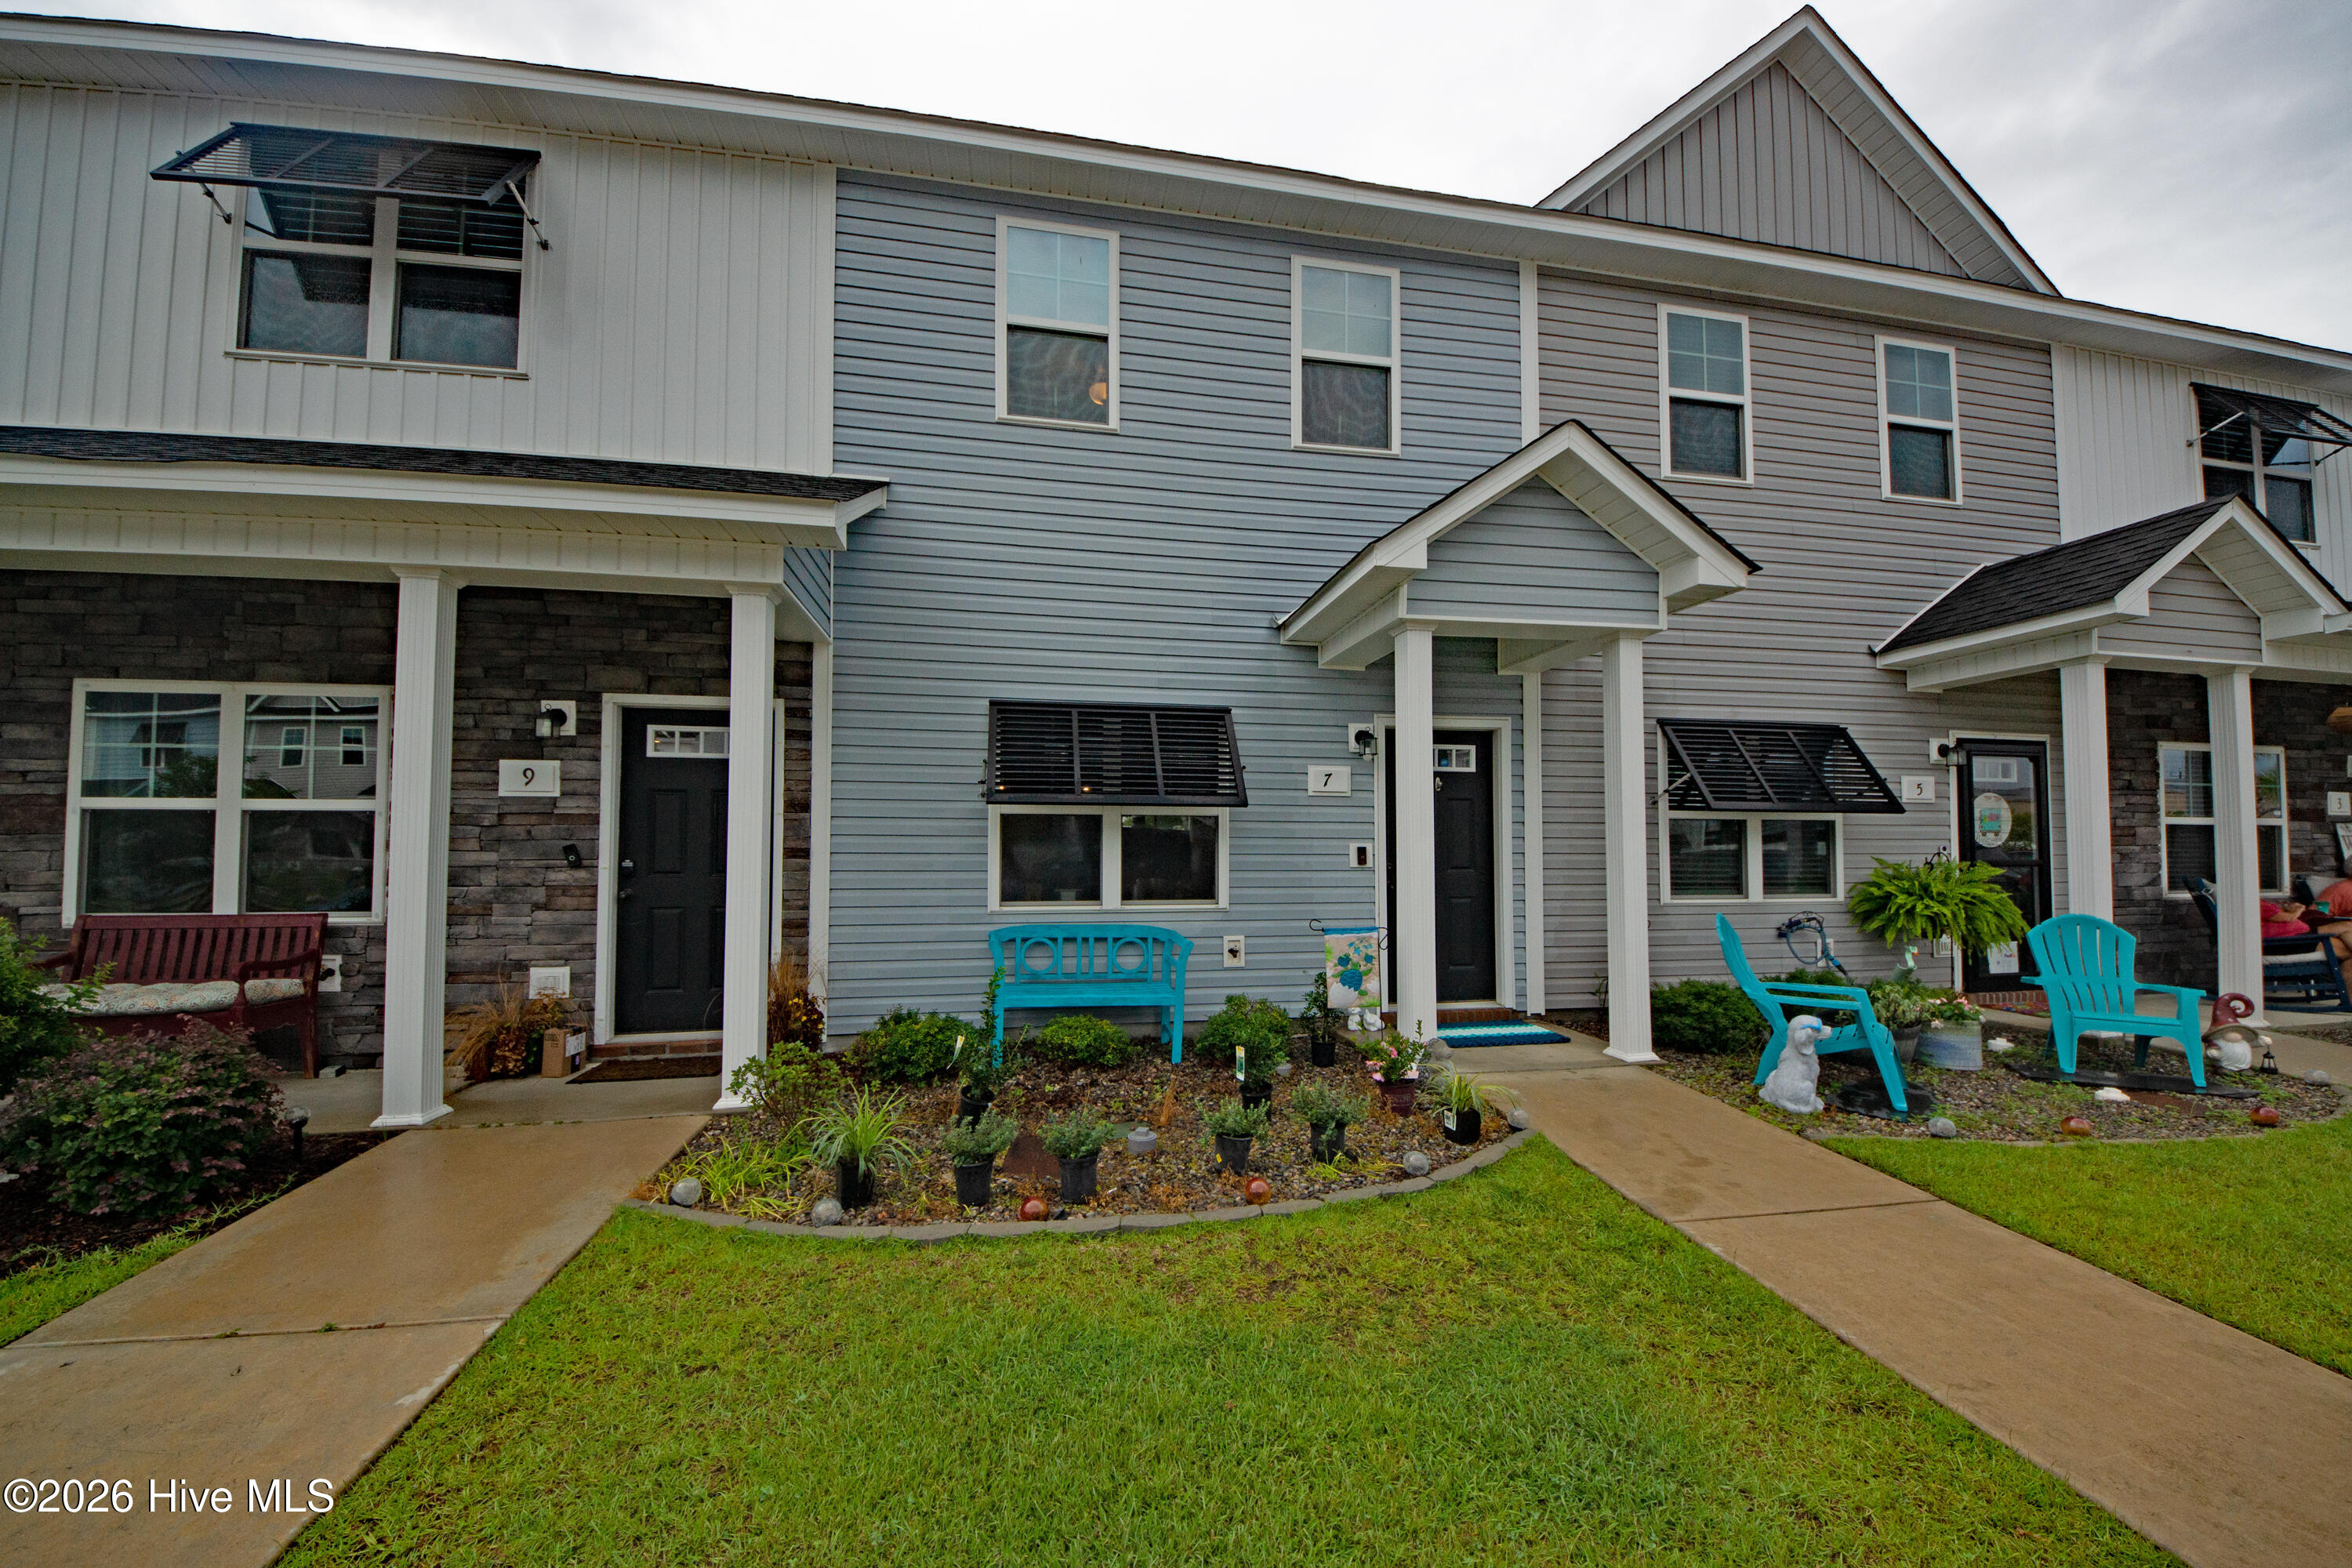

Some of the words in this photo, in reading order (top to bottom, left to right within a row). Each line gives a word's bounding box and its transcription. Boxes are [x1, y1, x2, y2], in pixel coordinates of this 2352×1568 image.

[522, 768, 535, 786] 9
[1323, 772, 1333, 787] 7
[1916, 782, 1923, 796] 5
[2337, 797, 2342, 809] 3
